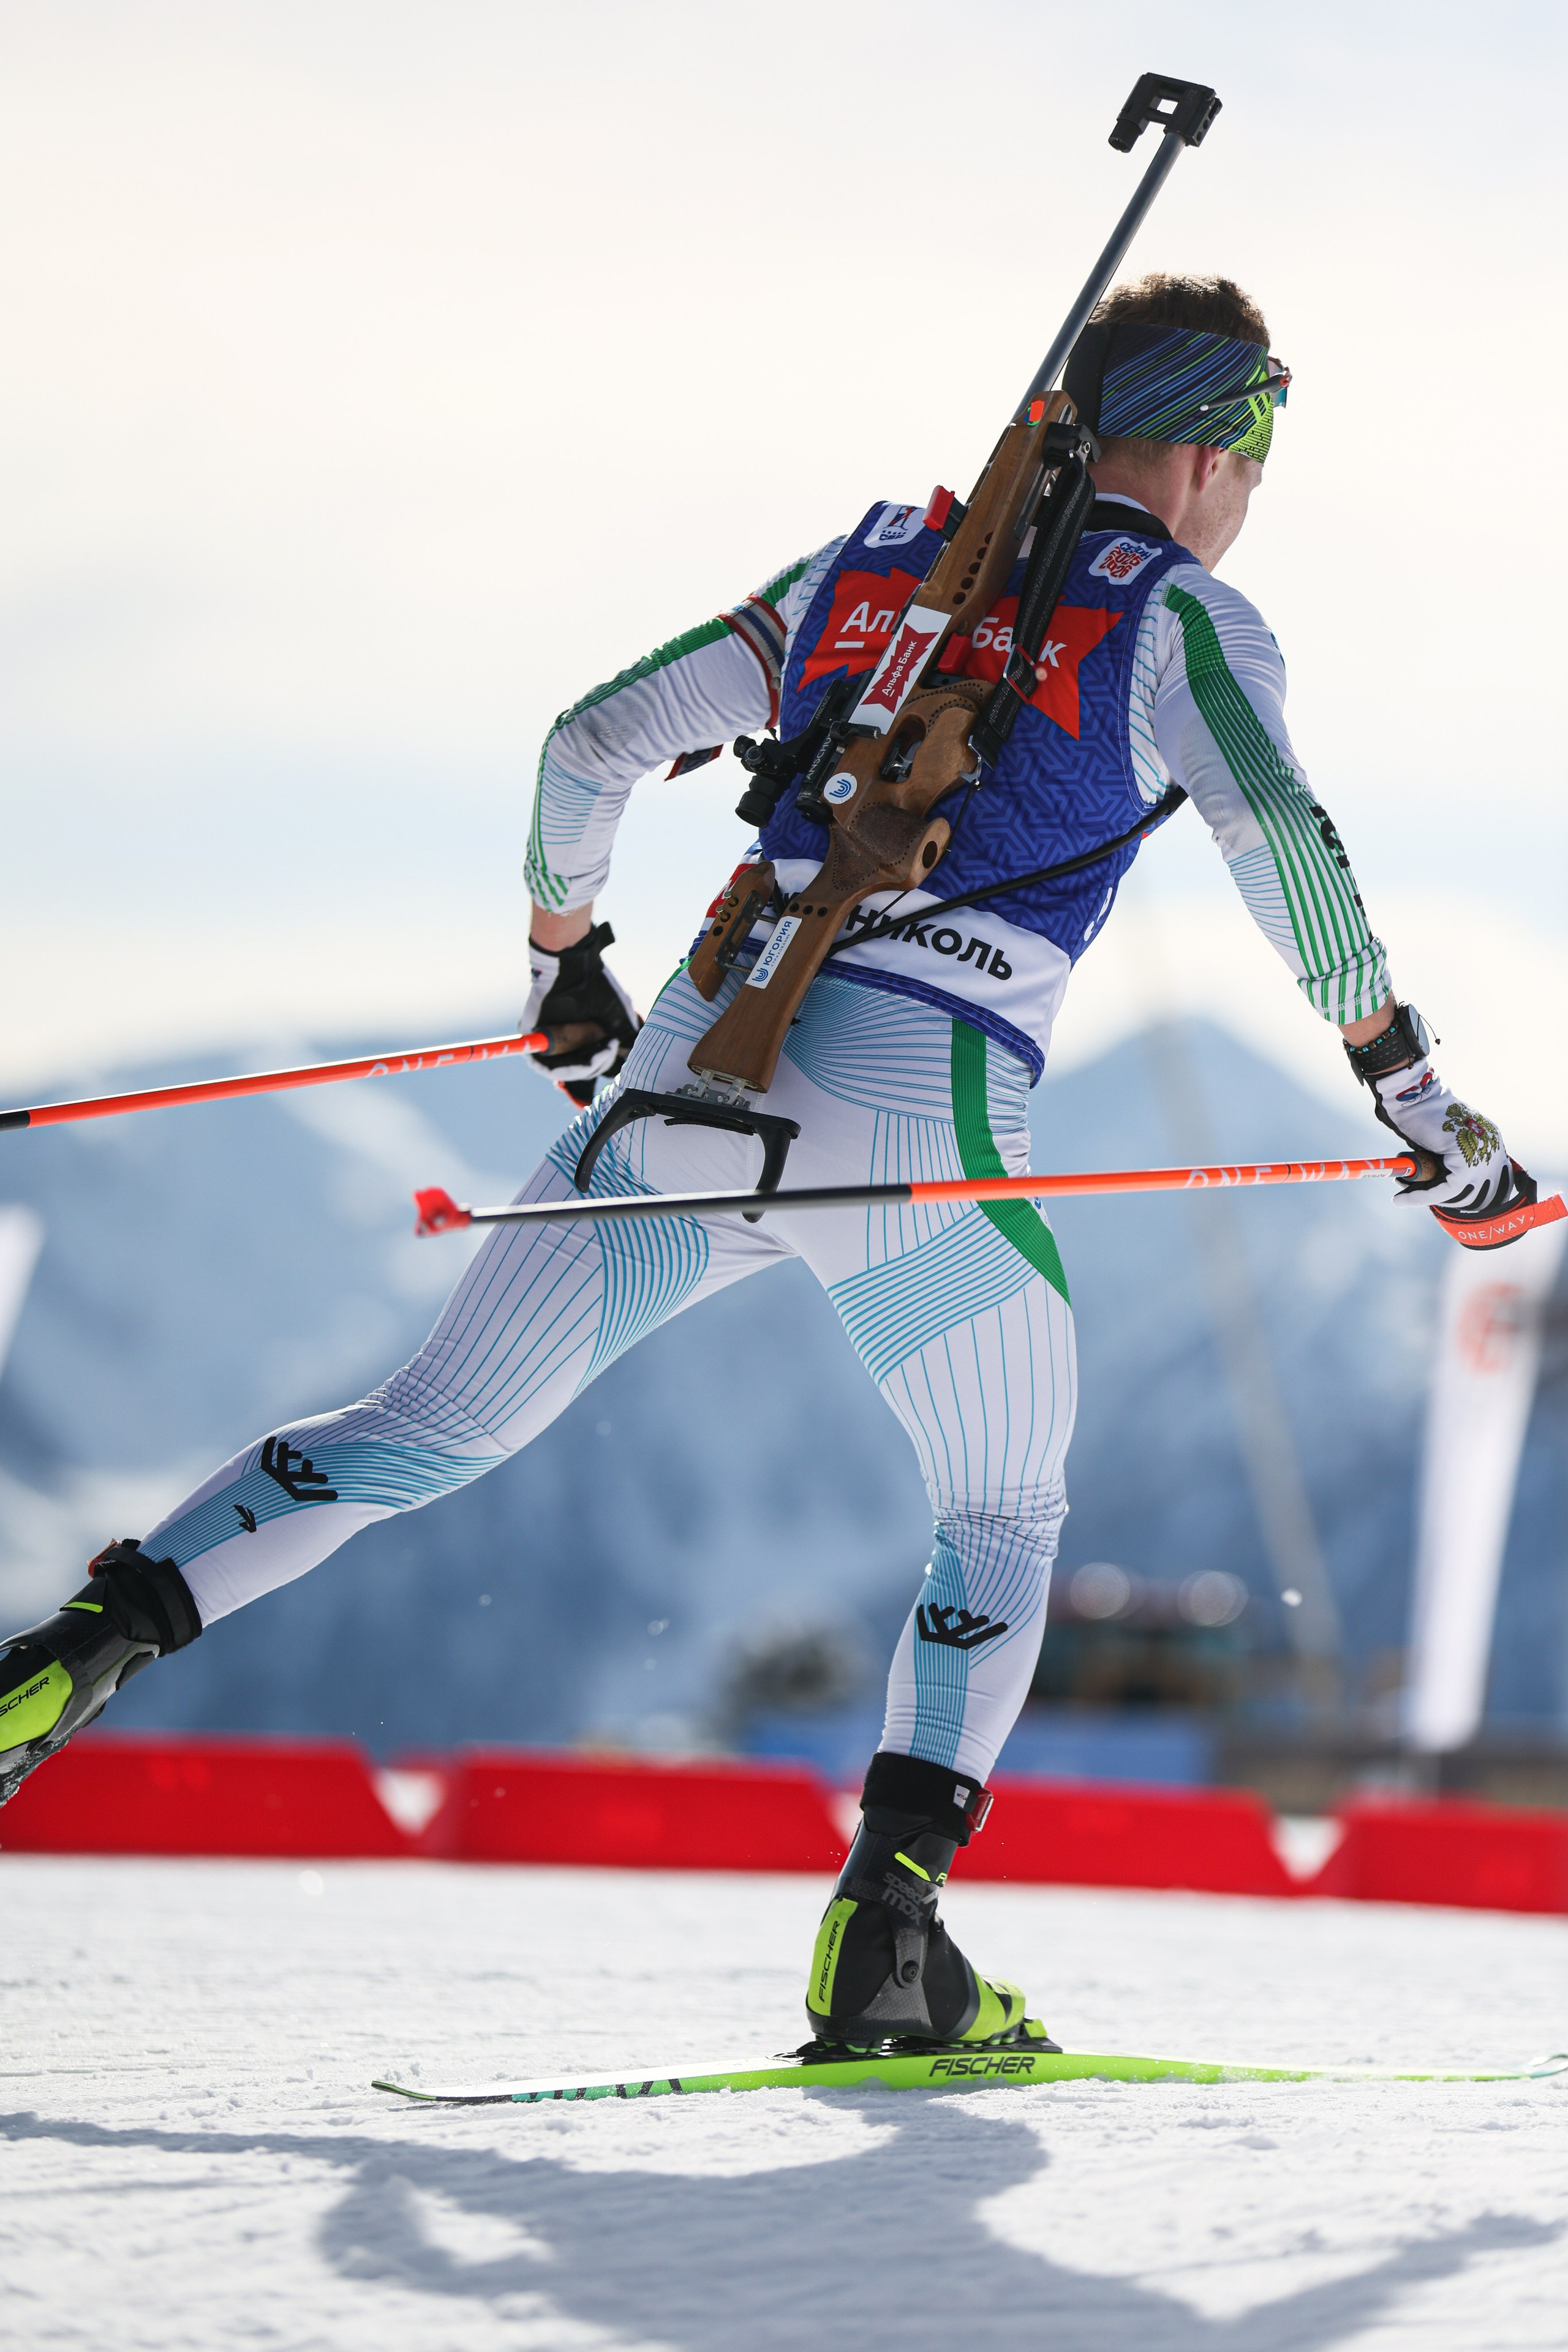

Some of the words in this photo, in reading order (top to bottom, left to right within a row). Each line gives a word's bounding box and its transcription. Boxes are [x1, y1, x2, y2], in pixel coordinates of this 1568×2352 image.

[1098, 556, 1133, 578] 2026
[1109, 546, 1144, 567] 2025
[972, 617, 1067, 668] Бак
[881, 665, 904, 696] Альфа
[898, 640, 917, 665] Банк
[806, 736, 832, 780] ANSCHU
[763, 921, 792, 966] ЮГОРИЯ
[771, 933, 790, 967] СТРАХОВАНИЕ
[0, 1676, 50, 1717] SCHER
[882, 1872, 924, 1907] speed
[818, 1920, 840, 2003] FISCHER
[929, 2056, 1036, 2077] FISCHER
